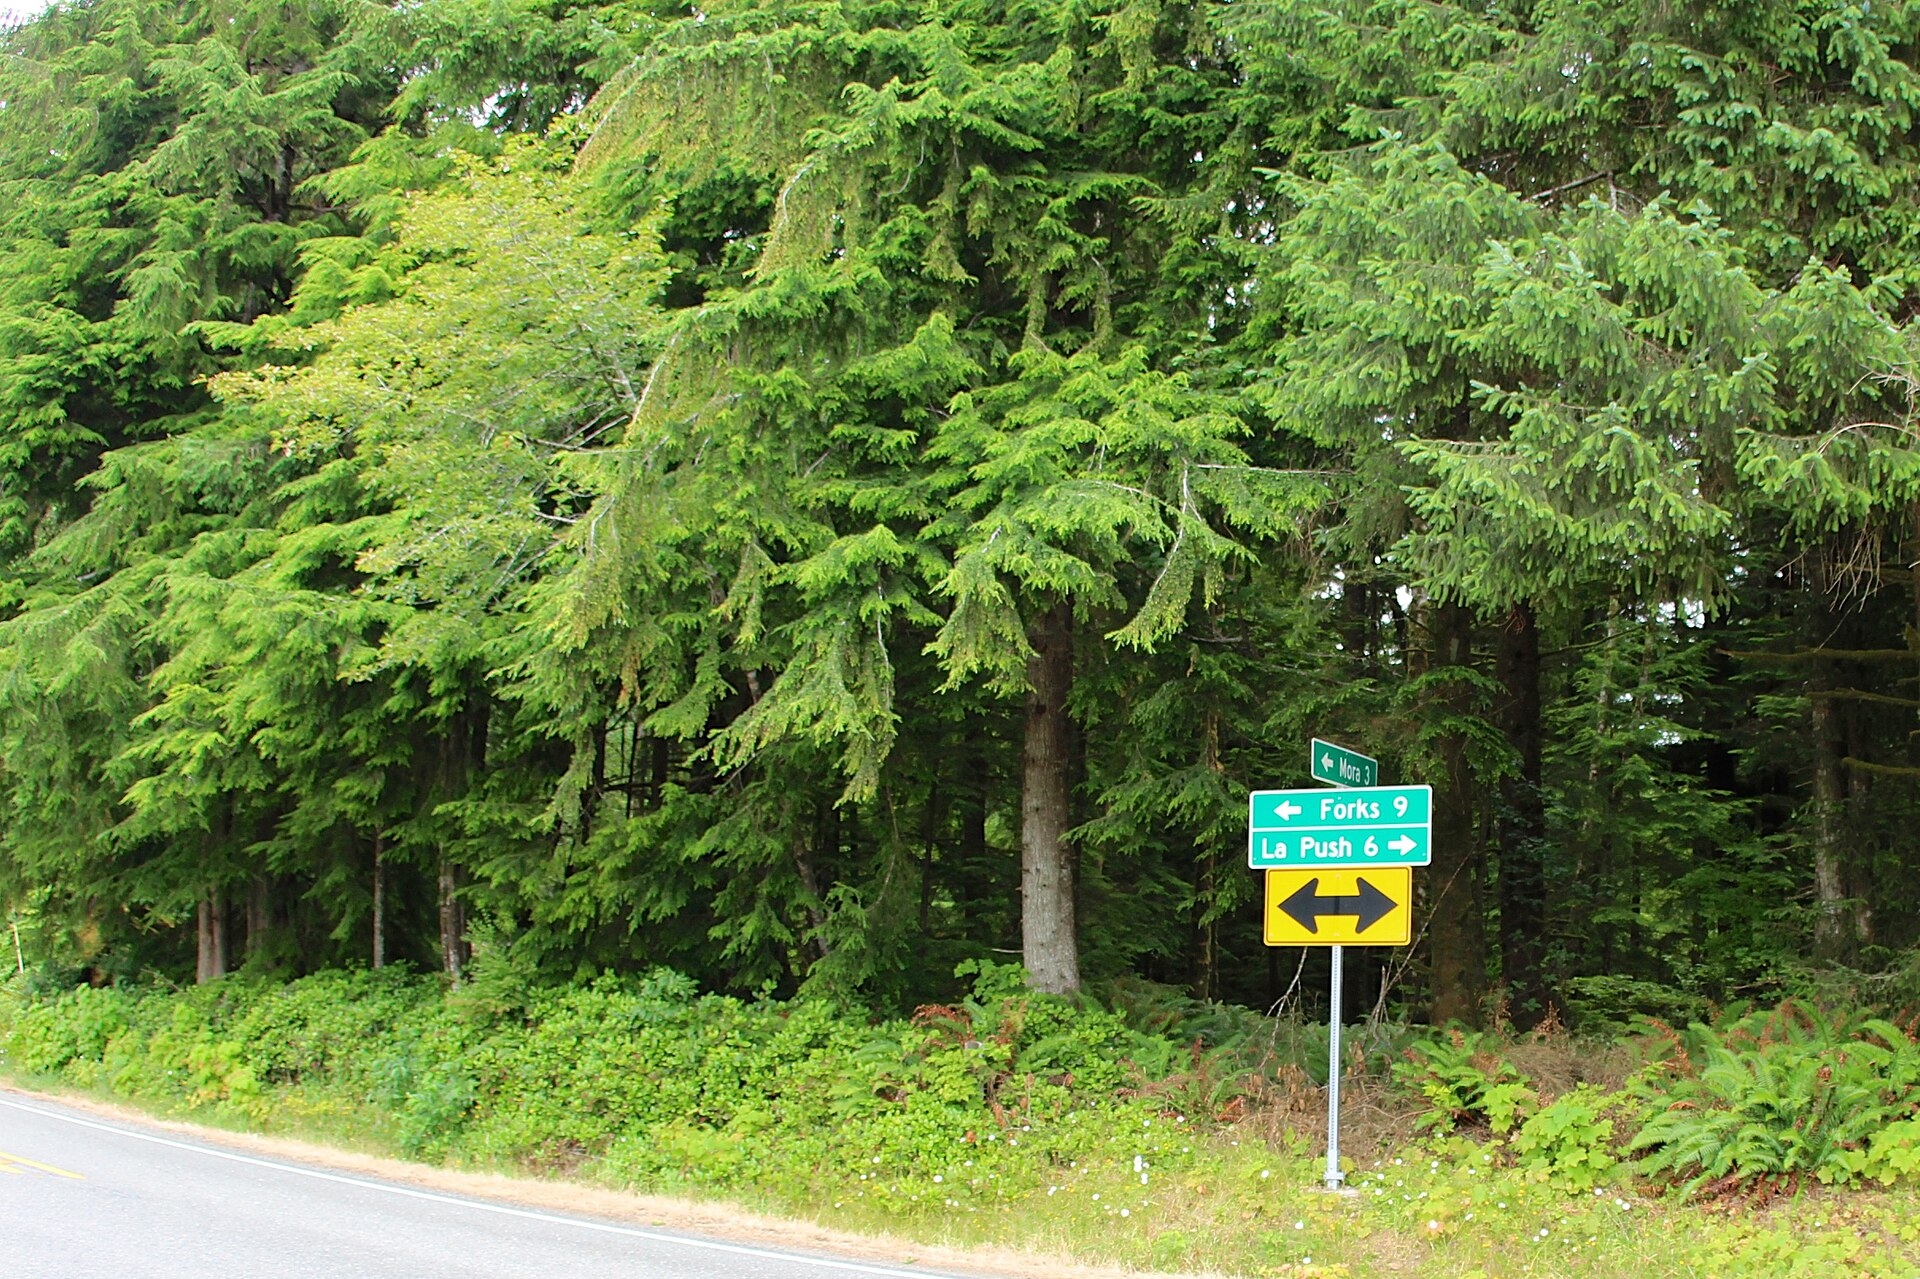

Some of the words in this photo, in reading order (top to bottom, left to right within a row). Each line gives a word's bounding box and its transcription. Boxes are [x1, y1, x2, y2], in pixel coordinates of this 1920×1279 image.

[1339, 757, 1361, 783] Mora
[1364, 766, 1370, 786] 3
[1320, 797, 1380, 820] Forks
[1392, 796, 1408, 818] 9
[1261, 837, 1287, 859] La
[1300, 836, 1352, 859] Push
[1364, 835, 1379, 857] 6
